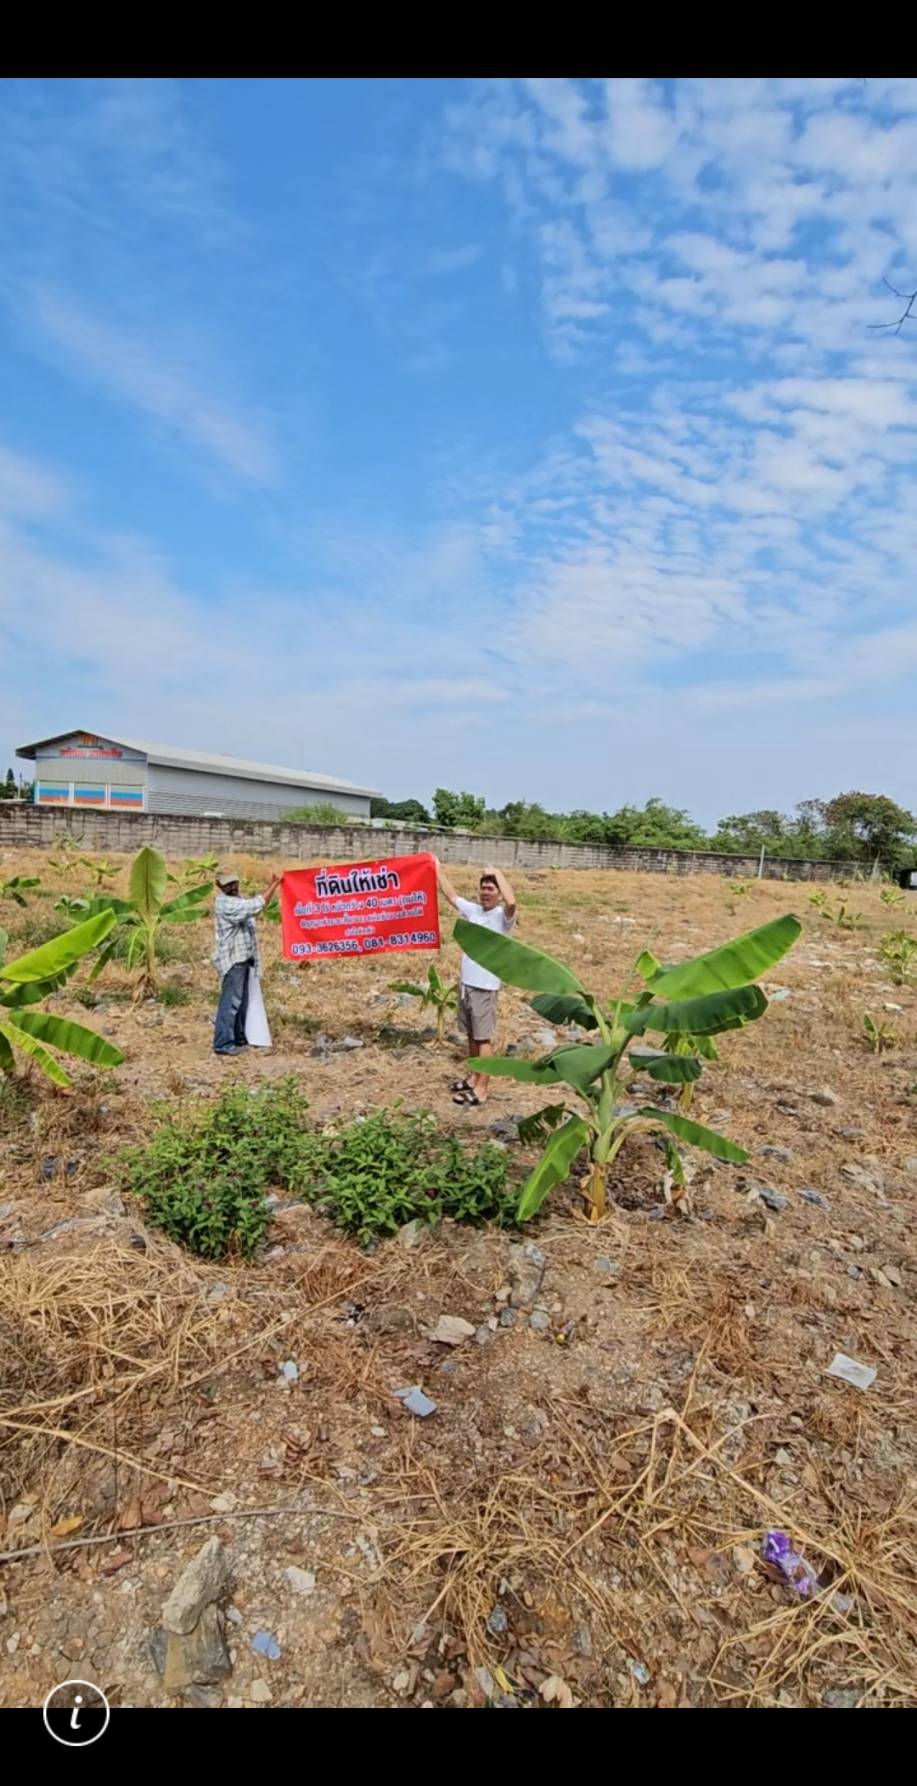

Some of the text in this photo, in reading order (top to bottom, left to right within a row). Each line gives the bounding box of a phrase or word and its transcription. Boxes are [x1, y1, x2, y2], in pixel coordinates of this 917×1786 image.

[316, 867, 399, 897] ที่ดินให้เช่า
[367, 897, 378, 908] 40
[364, 932, 436, 949] 081-8314960
